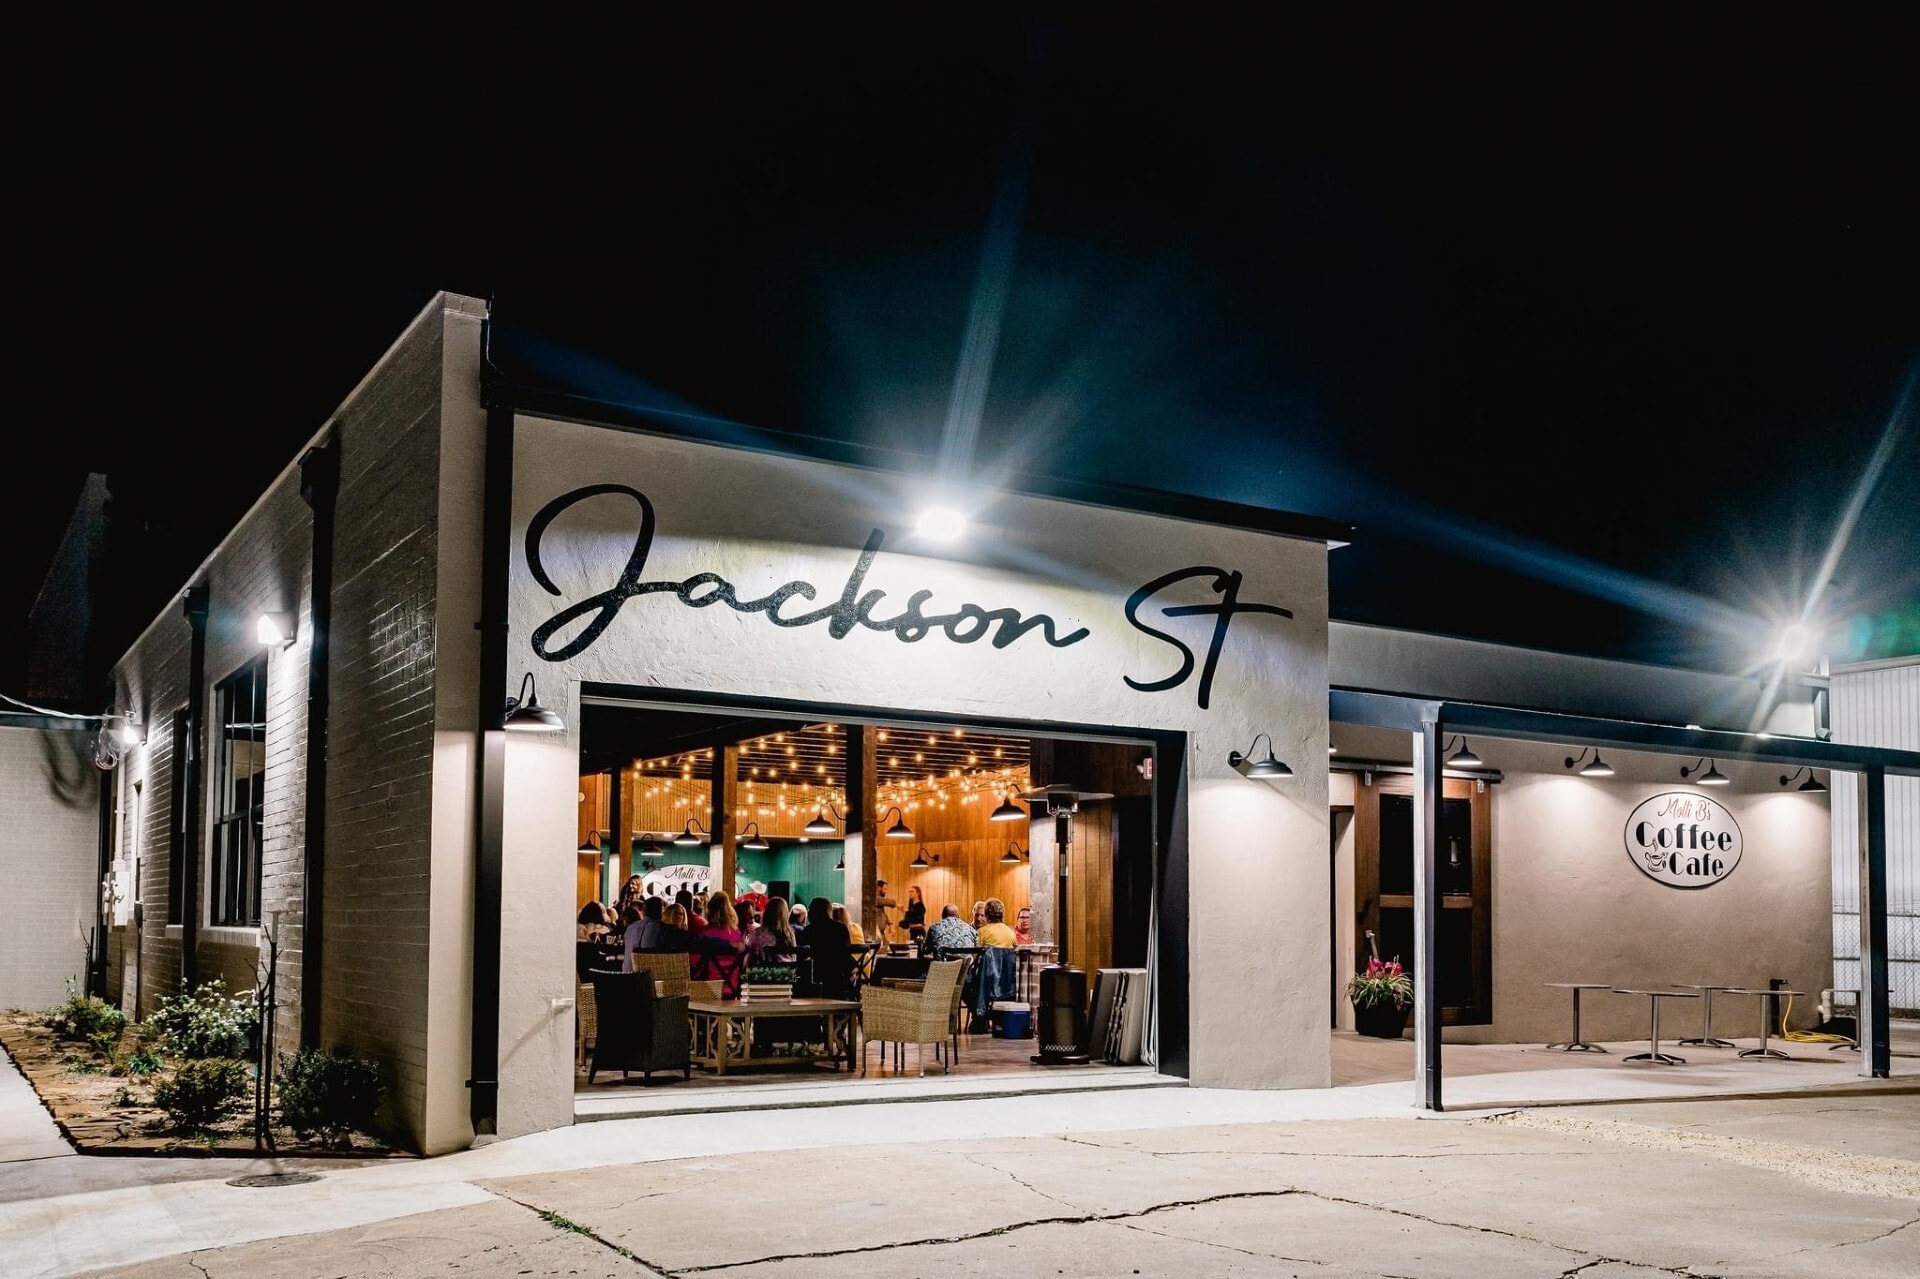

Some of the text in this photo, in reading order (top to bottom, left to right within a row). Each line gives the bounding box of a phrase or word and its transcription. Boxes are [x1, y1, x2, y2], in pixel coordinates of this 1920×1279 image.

[525, 483, 1293, 709] Jackson St
[1657, 797, 1711, 821] Molli B's
[1635, 821, 1732, 852] Coffee
[664, 866, 696, 880] Molli
[1669, 852, 1724, 877] Cafe
